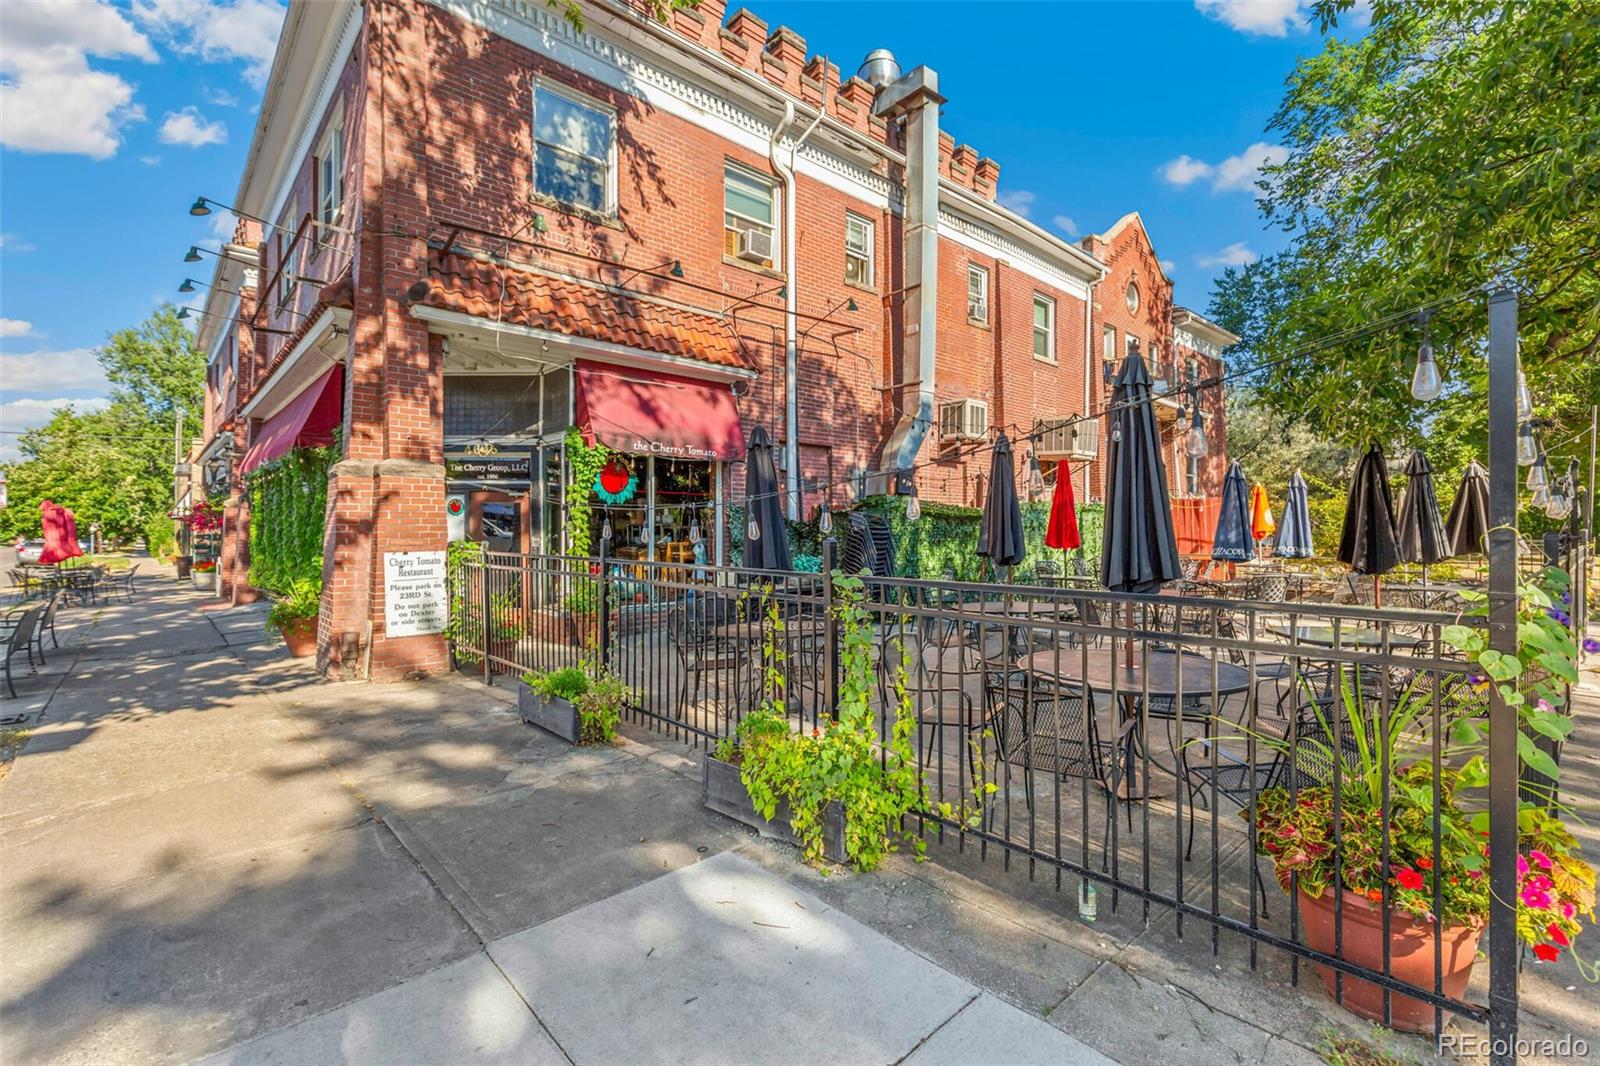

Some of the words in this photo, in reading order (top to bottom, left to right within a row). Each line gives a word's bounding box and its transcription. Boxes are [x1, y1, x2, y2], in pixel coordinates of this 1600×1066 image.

[633, 440, 648, 451] the
[650, 441, 685, 455] Cherry
[686, 445, 717, 457] Tomato
[464, 464, 486, 472] Cherry
[389, 558, 414, 567] Cherry
[416, 557, 441, 566] Tomato
[398, 568, 433, 577] Restaurant
[422, 601, 438, 609] park
